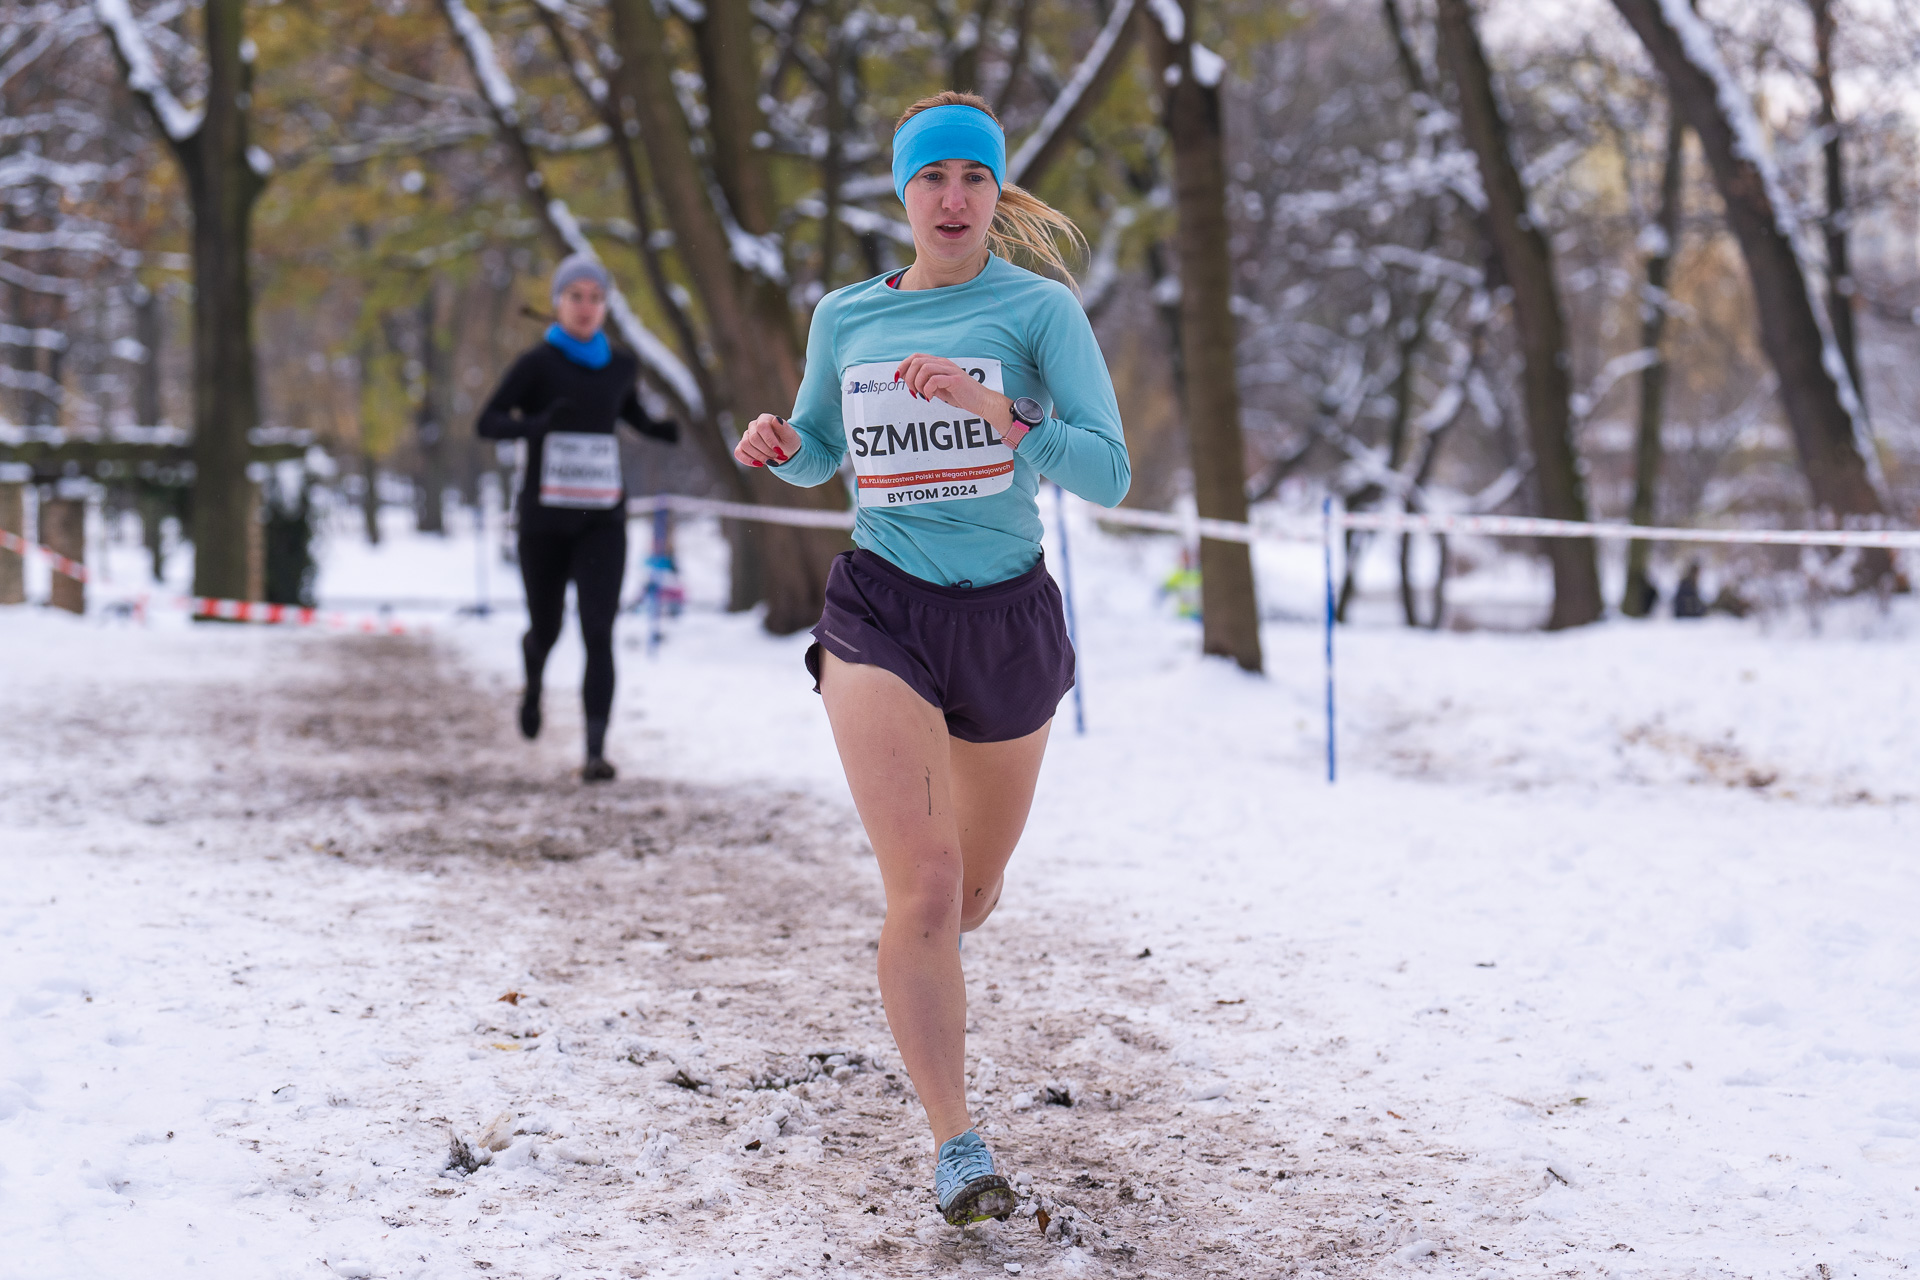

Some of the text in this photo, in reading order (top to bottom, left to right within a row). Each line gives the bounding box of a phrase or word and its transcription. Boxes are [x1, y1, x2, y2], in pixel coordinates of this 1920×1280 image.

[852, 380, 905, 394] Bellsport
[852, 418, 1003, 457] SZMIGIEL
[880, 476, 914, 484] Mistrzostwa
[942, 471, 968, 479] Biegach
[887, 485, 978, 503] BYTOM 2024
